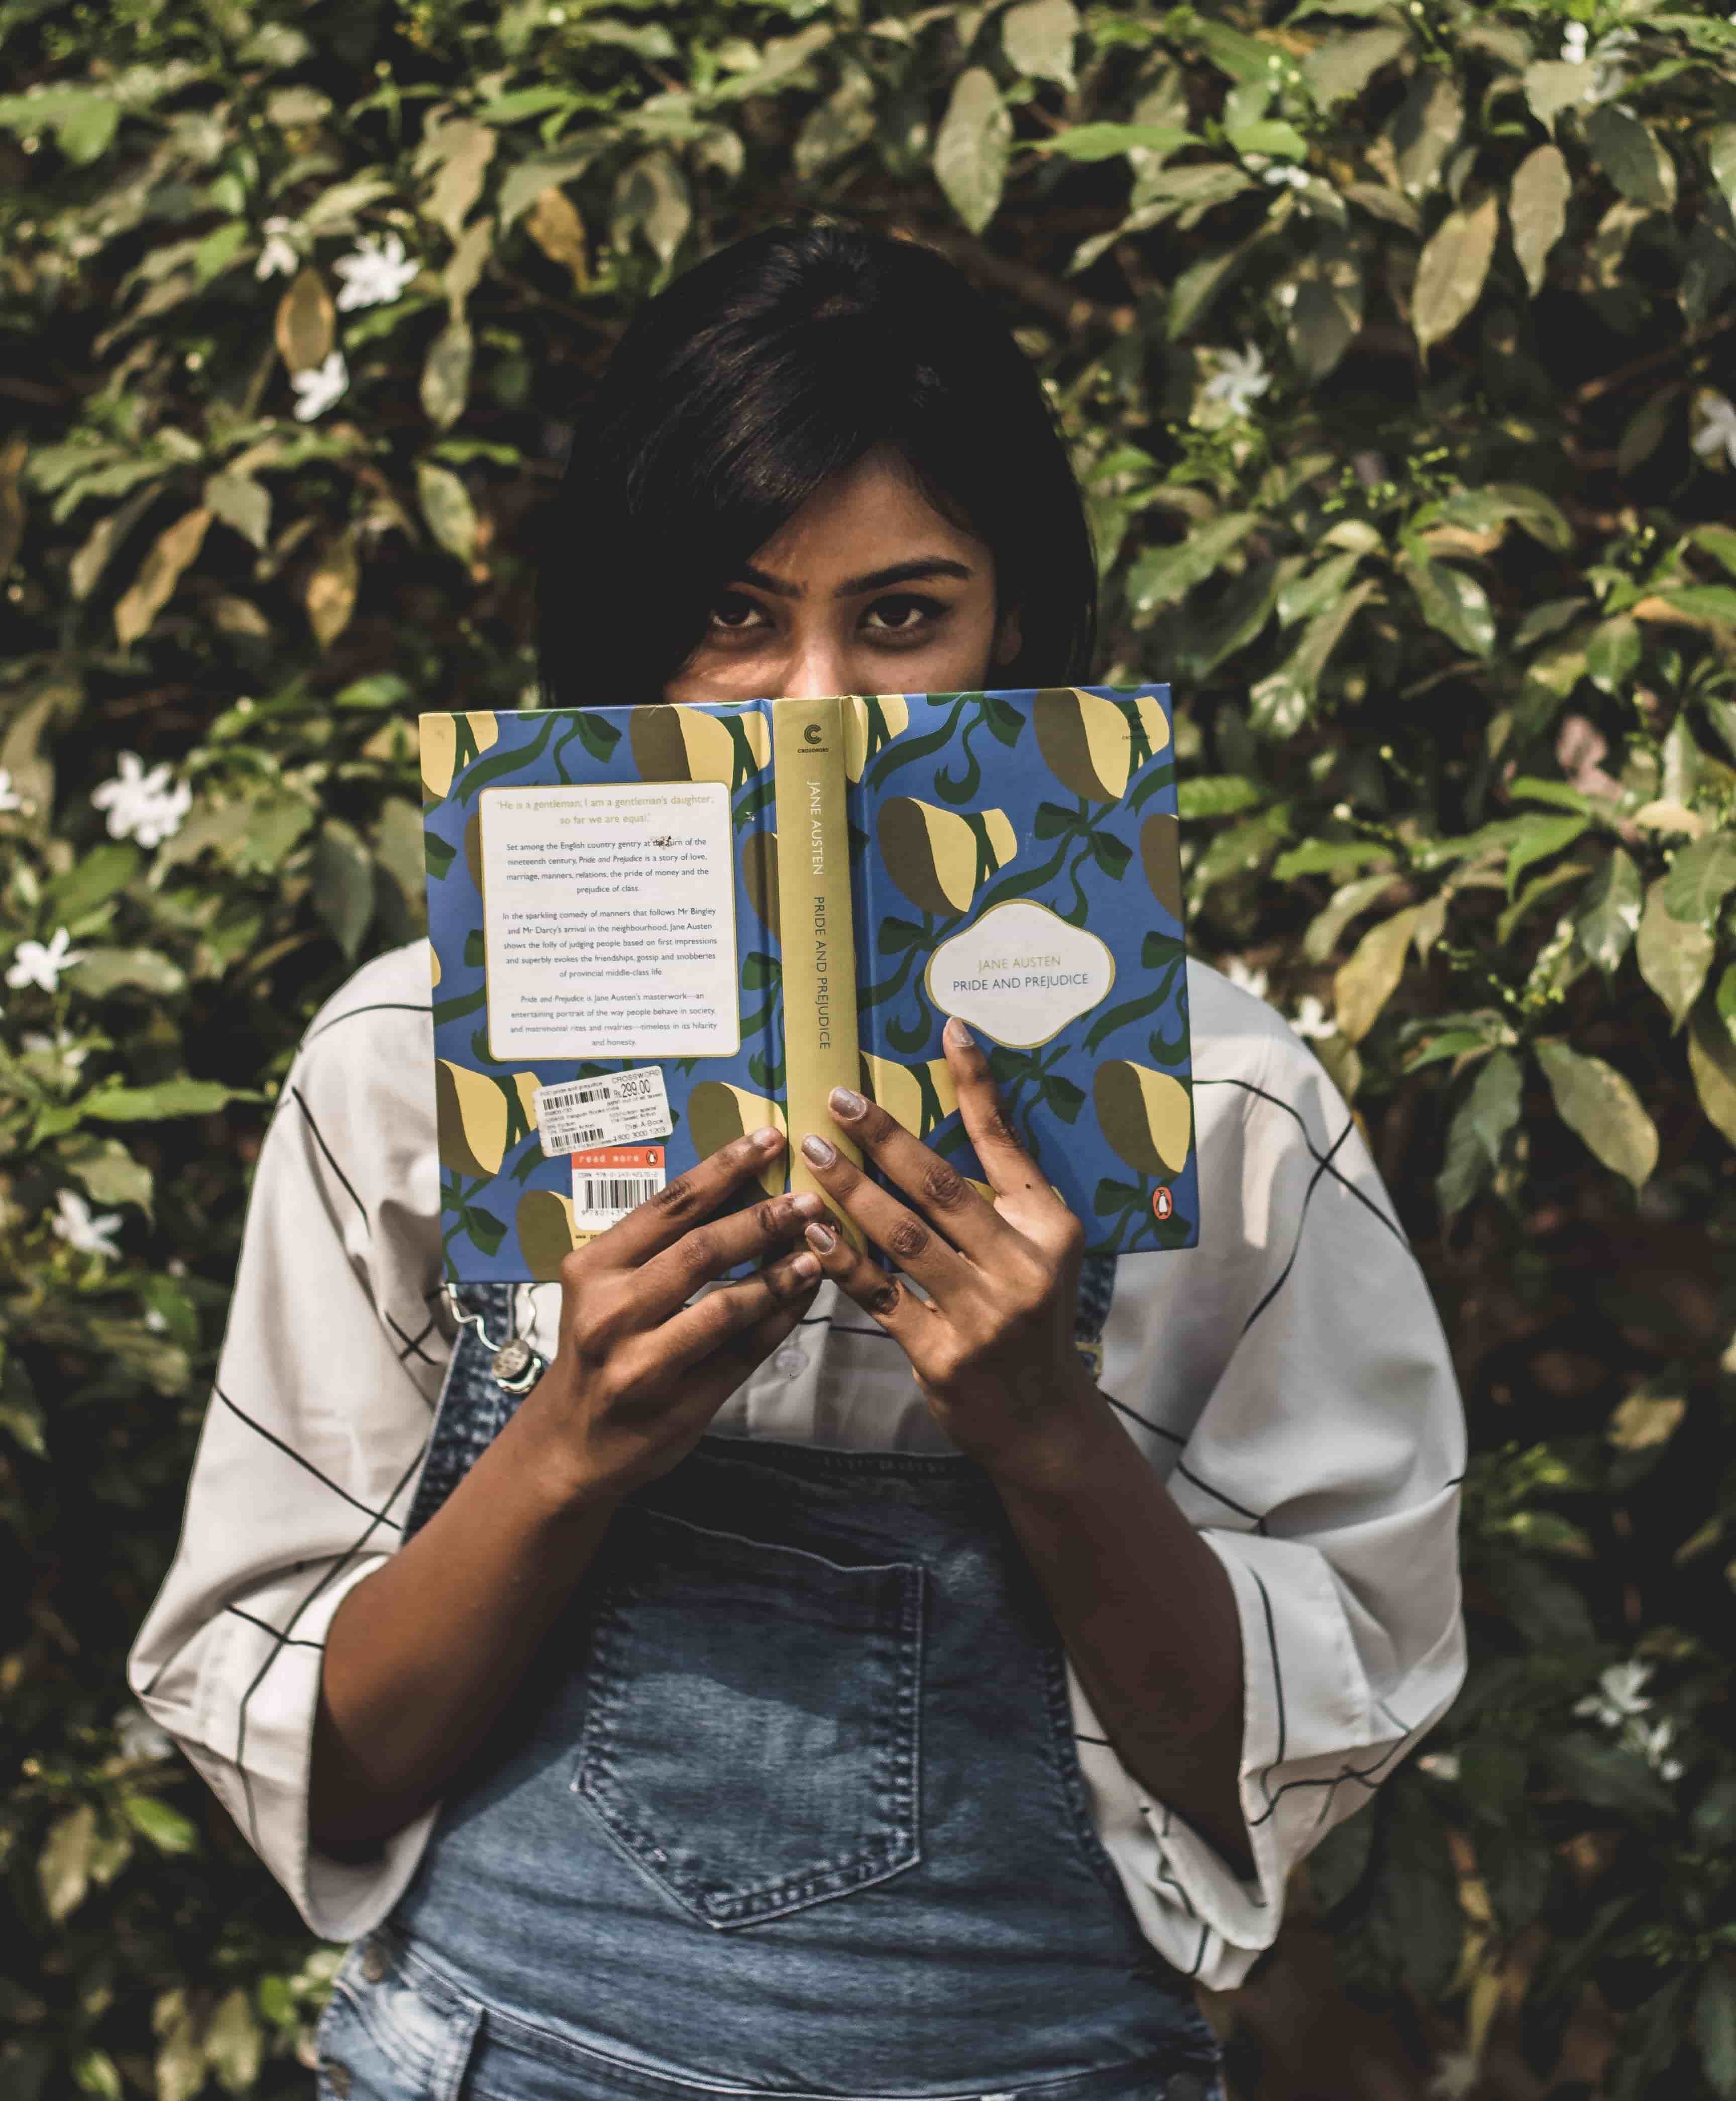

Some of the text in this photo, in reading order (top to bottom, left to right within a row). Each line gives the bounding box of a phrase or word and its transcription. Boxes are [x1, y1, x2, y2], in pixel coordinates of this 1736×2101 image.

[584, 798, 588, 806] I
[807, 782, 824, 875] JANE AUSTEN
[560, 841, 585, 850] English
[587, 841, 615, 849] country
[618, 840, 641, 849] gentry
[507, 857, 546, 865] nineteenth
[612, 855, 642, 864] Prejudice
[659, 854, 678, 863] story
[624, 869, 643, 879] pride
[576, 886, 610, 895] prejudice
[526, 912, 557, 921] sparkling
[559, 911, 587, 920] comedy
[691, 907, 716, 916] Bingley
[535, 926, 562, 935] Darcy's
[670, 923, 685, 932] Jane
[542, 941, 557, 950] folly
[569, 940, 594, 950] judging
[596, 940, 621, 949] people
[675, 938, 717, 947] impressions
[521, 956, 552, 965] superbly
[636, 953, 659, 963] gossip
[977, 956, 1061, 973] JANE AUSTEN
[569, 969, 603, 979] provincial
[814, 897, 831, 1049] PRIDE AND PREJUDICE
[953, 973, 1089, 991] PRIDE AND PREJUDICE
[554, 995, 584, 1004] Prejudice
[594, 994, 609, 1003] Jane
[510, 1010, 555, 1019] entertaining
[556, 1009, 584, 1019] portrait
[626, 1008, 652, 1017] people
[525, 1025, 568, 1033] matrimonial
[692, 1022, 717, 1030] hilarity
